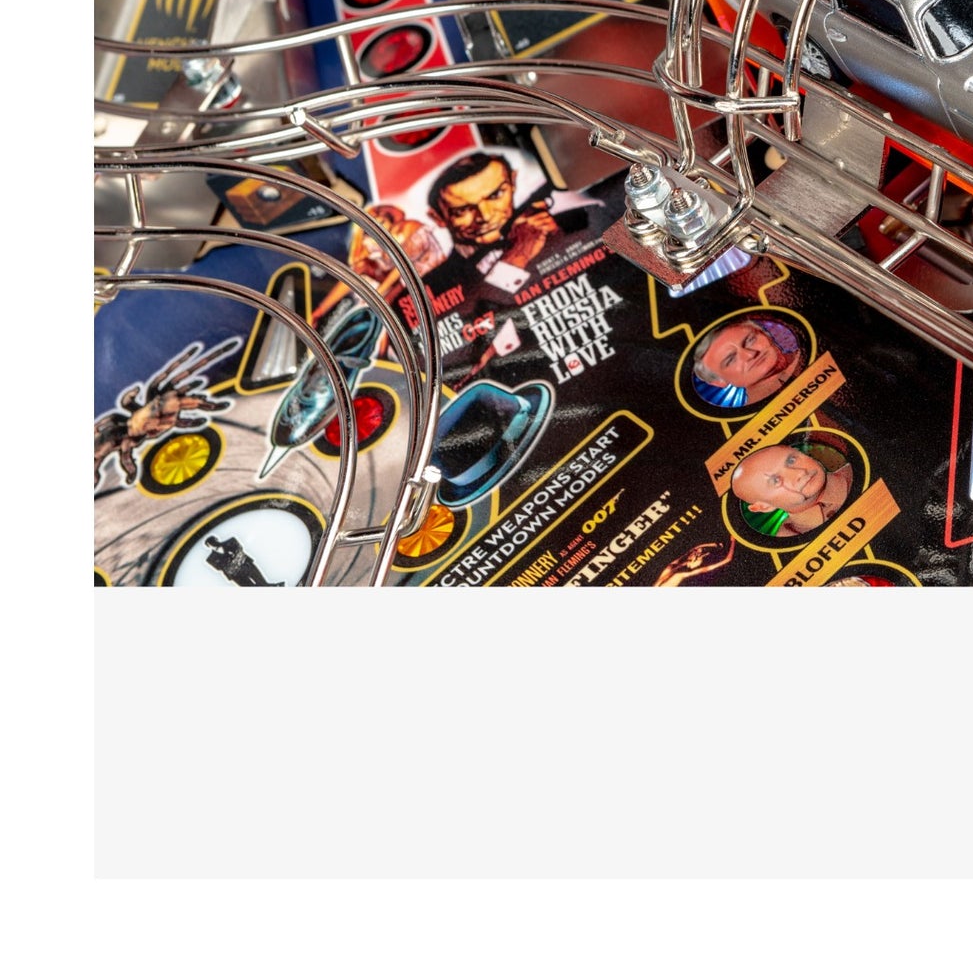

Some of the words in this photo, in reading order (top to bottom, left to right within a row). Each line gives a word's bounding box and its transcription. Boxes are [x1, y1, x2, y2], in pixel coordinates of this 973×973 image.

[515, 283, 542, 306] IAN
[520, 273, 596, 326] FROM
[531, 285, 623, 345] RUSSIA
[539, 313, 613, 362] WITH
[713, 461, 734, 481] AKA
[733, 434, 762, 460] MR.
[760, 365, 837, 436] HENDERSON
[484, 472, 571, 546] WEAPONS
[569, 426, 621, 473] START
[555, 452, 617, 507] MODES
[582, 491, 622, 534] 007
[556, 541, 597, 577] FLEMING'S
[784, 516, 866, 587] BLOFELD
